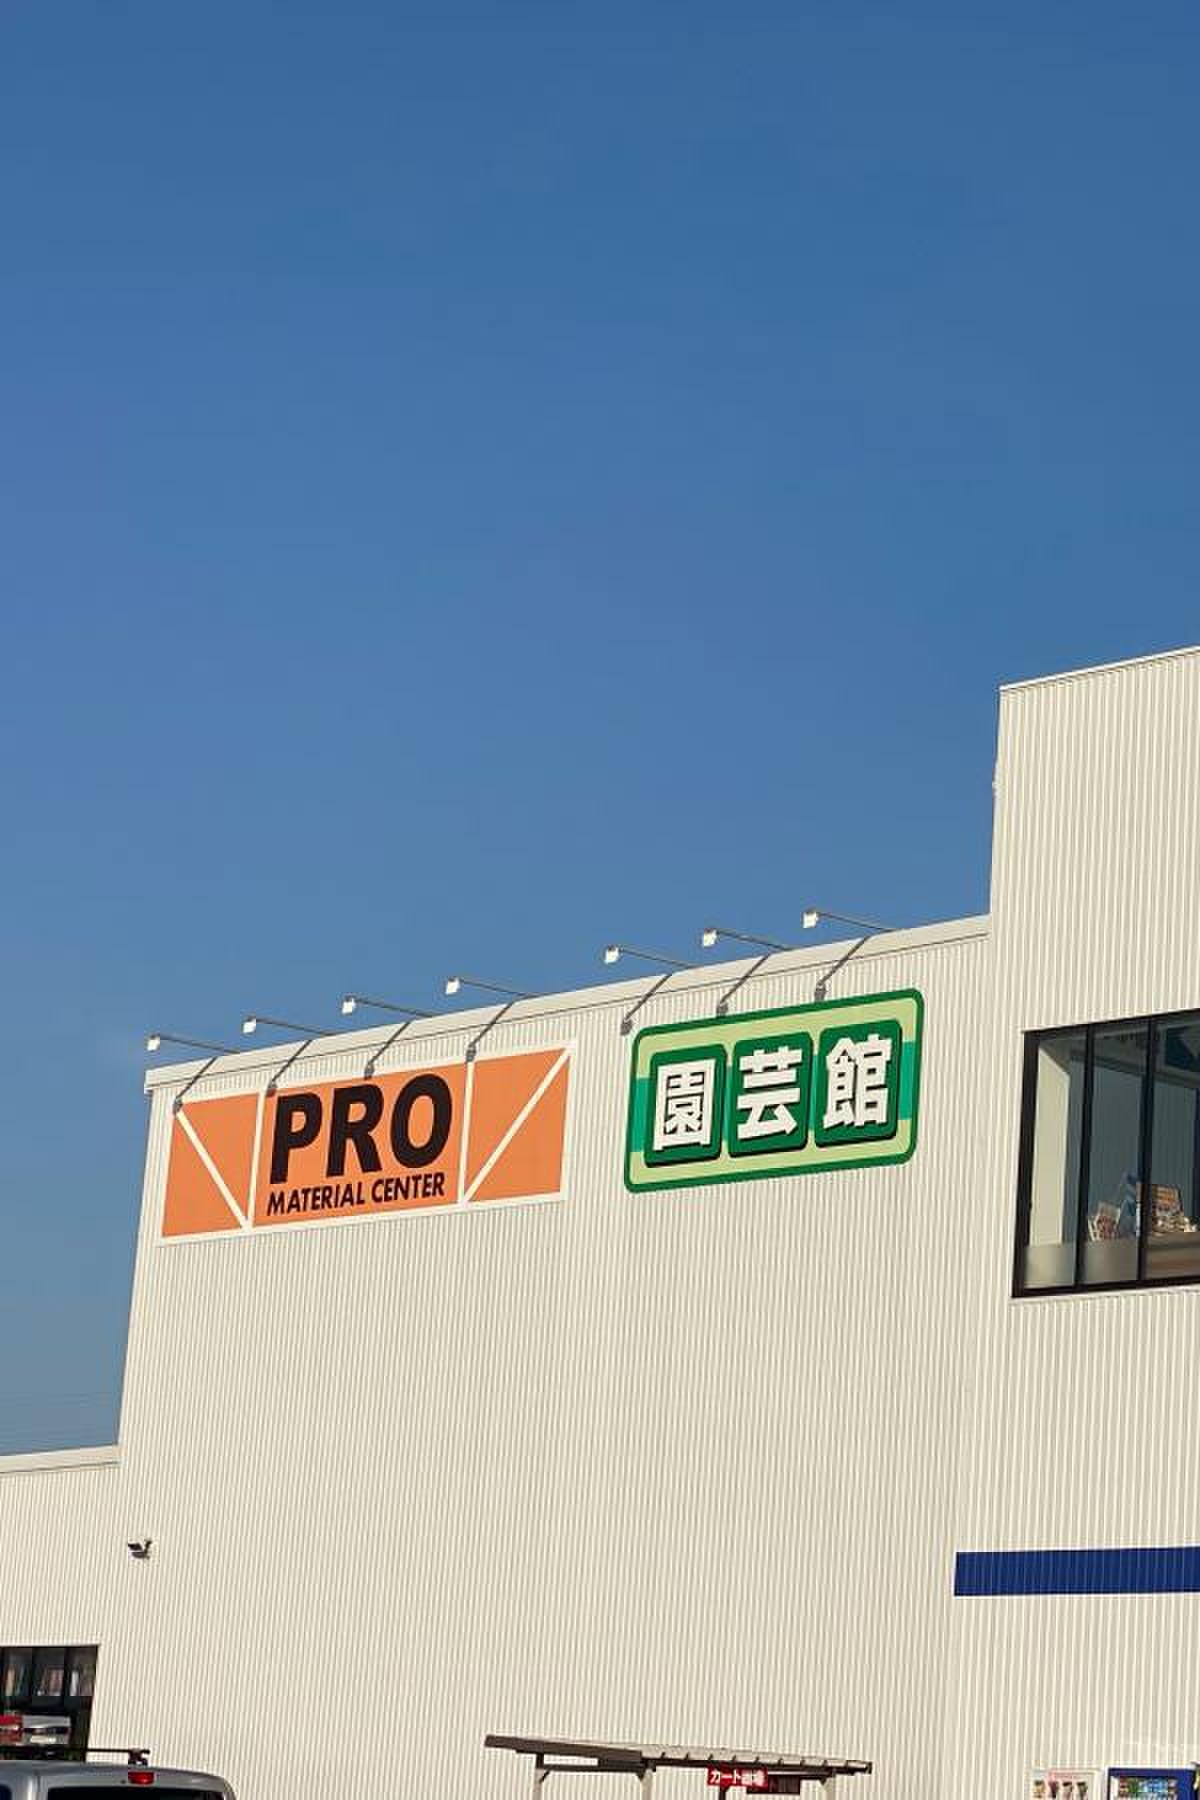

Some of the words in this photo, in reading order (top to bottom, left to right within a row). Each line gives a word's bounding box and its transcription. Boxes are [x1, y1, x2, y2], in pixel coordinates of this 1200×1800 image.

[270, 1074, 452, 1184] PRO
[653, 1034, 893, 1151] 園芸館
[267, 1181, 365, 1216] MATERIAL
[371, 1172, 445, 1203] CENTER
